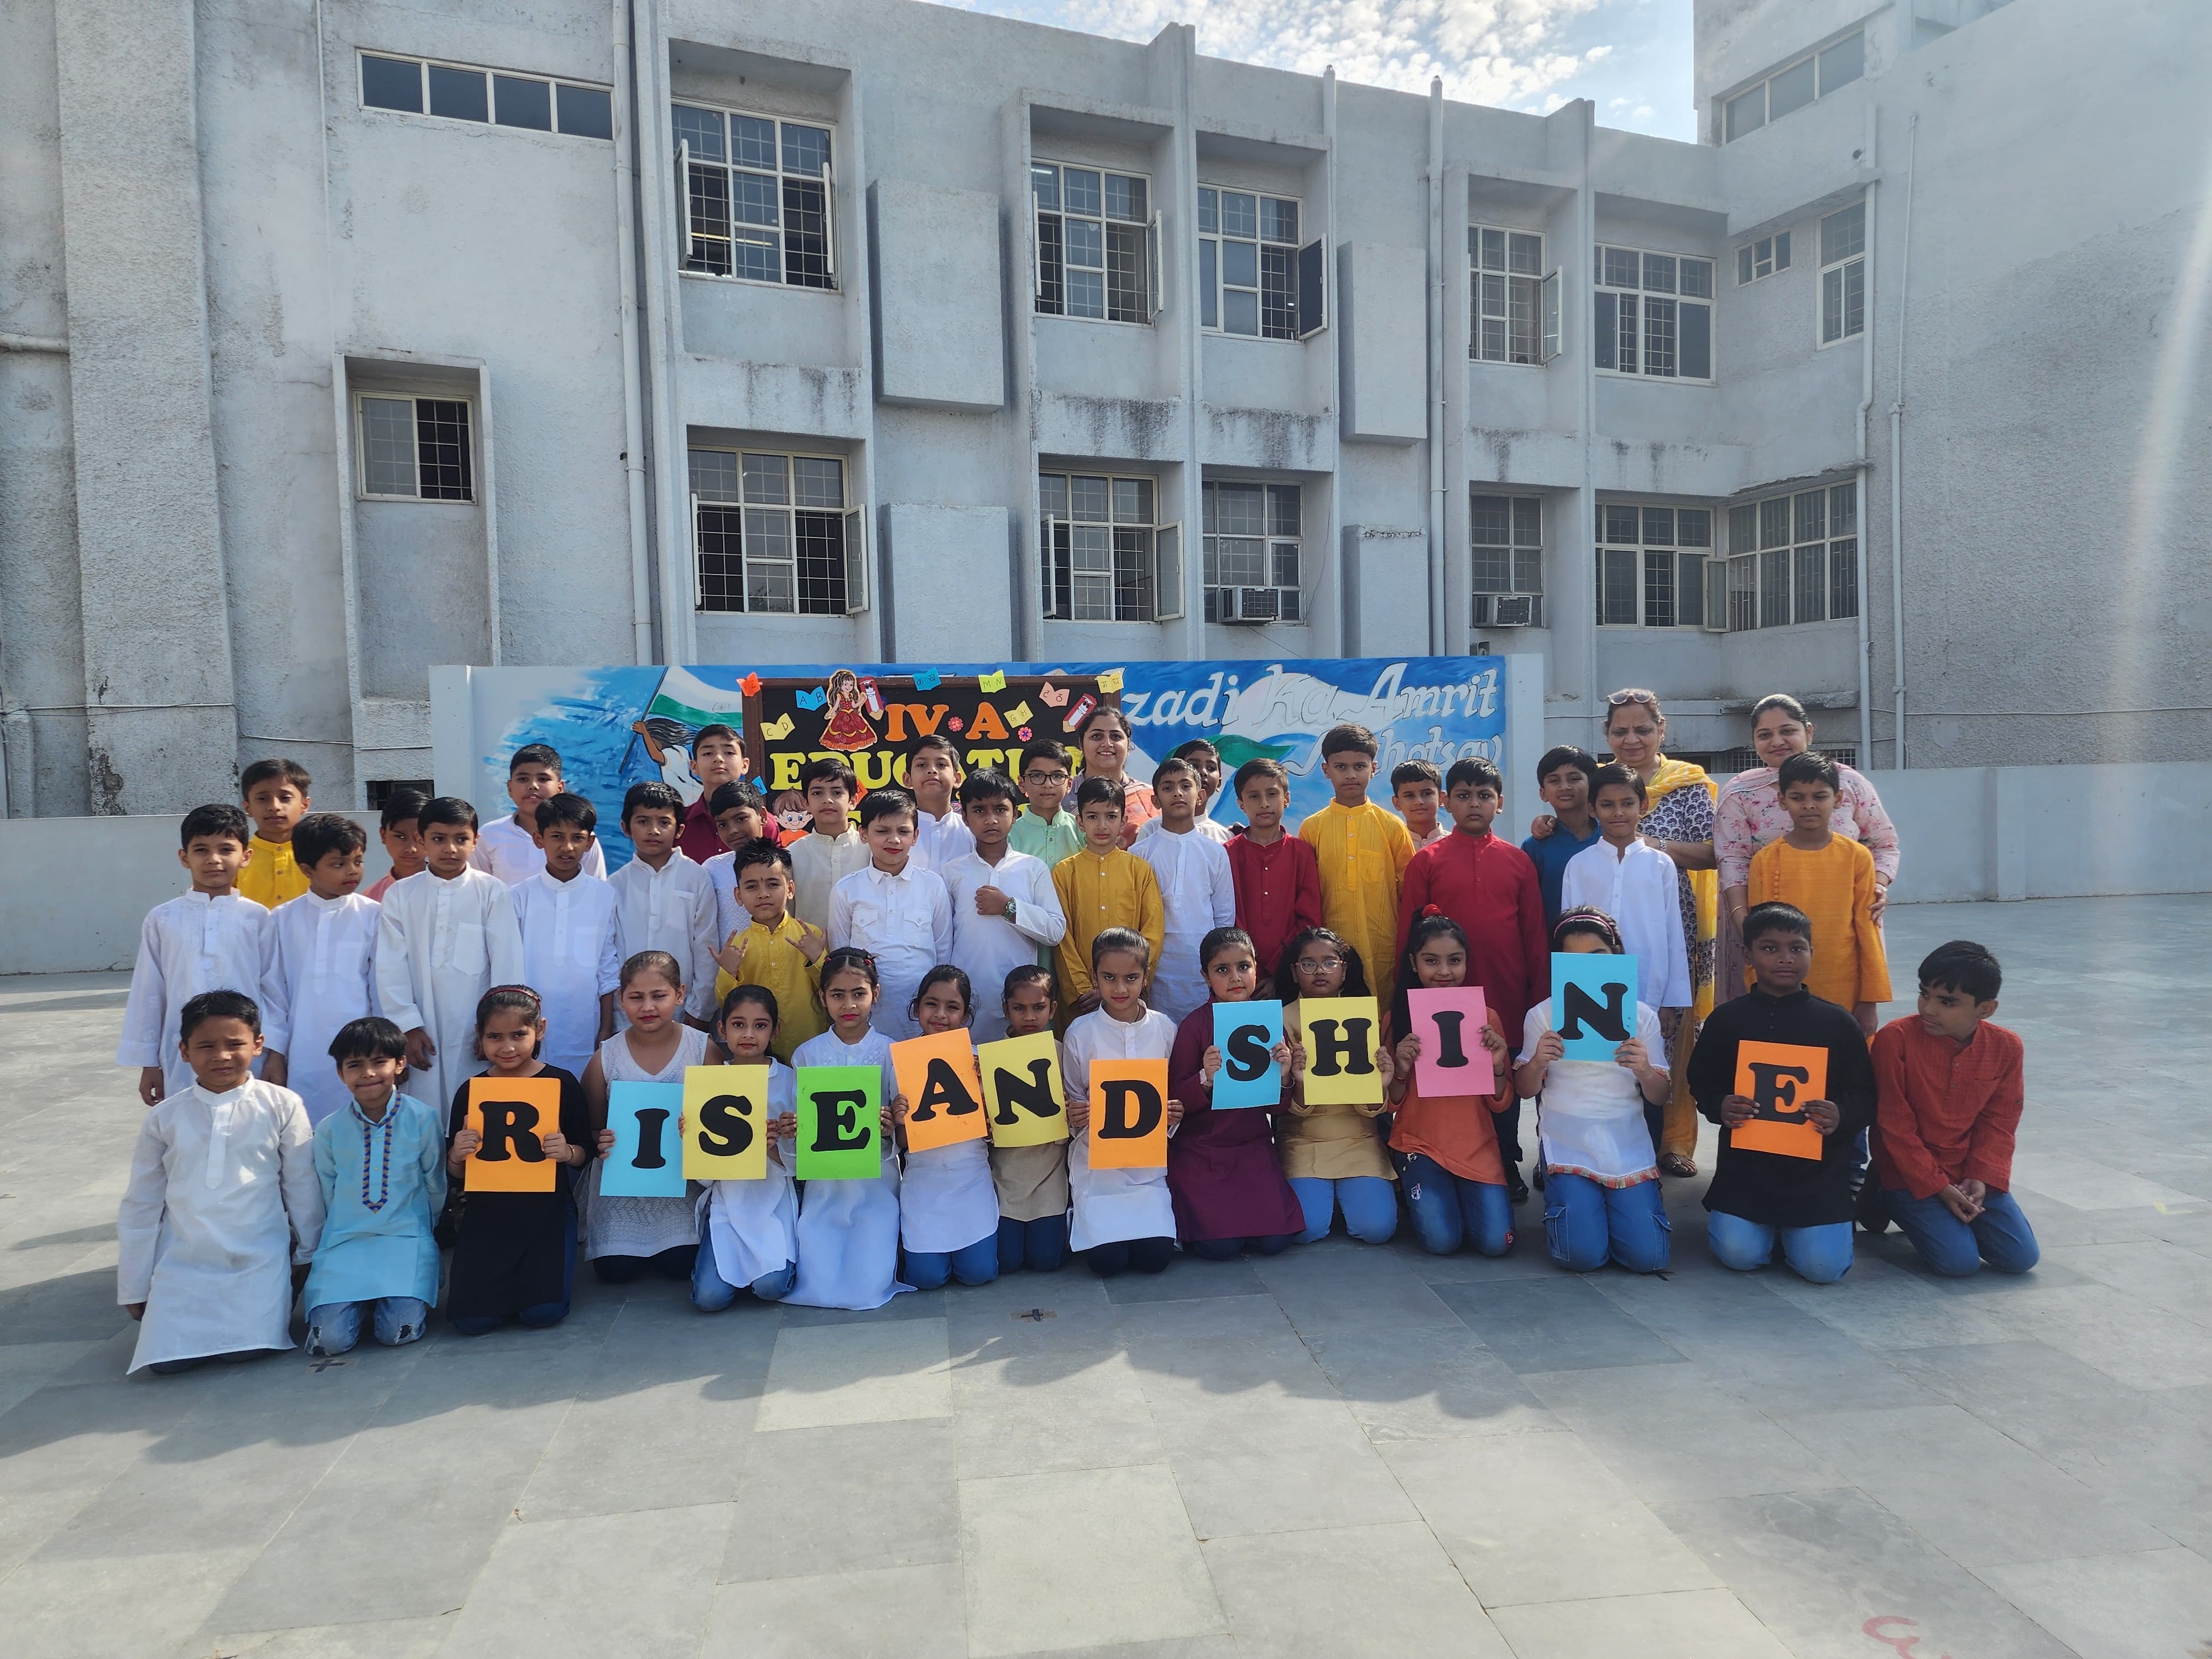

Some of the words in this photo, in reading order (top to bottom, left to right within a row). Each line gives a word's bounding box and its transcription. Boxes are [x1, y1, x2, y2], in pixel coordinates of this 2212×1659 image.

[800, 696, 807, 705] A
[815, 691, 823, 703] B
[996, 677, 1001, 686] N
[1102, 666, 1239, 728] zadi
[1336, 661, 1498, 723] Amrit
[766, 728, 773, 737] C
[781, 722, 788, 731] D
[885, 703, 950, 742] IV
[965, 702, 1009, 740] A
[1431, 1010, 1469, 1068] I
[1557, 982, 1631, 1041] N
[1225, 1024, 1270, 1081] S
[1308, 1018, 1375, 1076] H
[911, 1058, 978, 1122] A
[994, 1058, 1061, 1125] N
[1098, 1079, 1162, 1139] D
[1747, 1062, 1809, 1125] E
[476, 1101, 547, 1162] R
[632, 1108, 670, 1168] I
[699, 1094, 753, 1156] S
[810, 1089, 871, 1152] E
